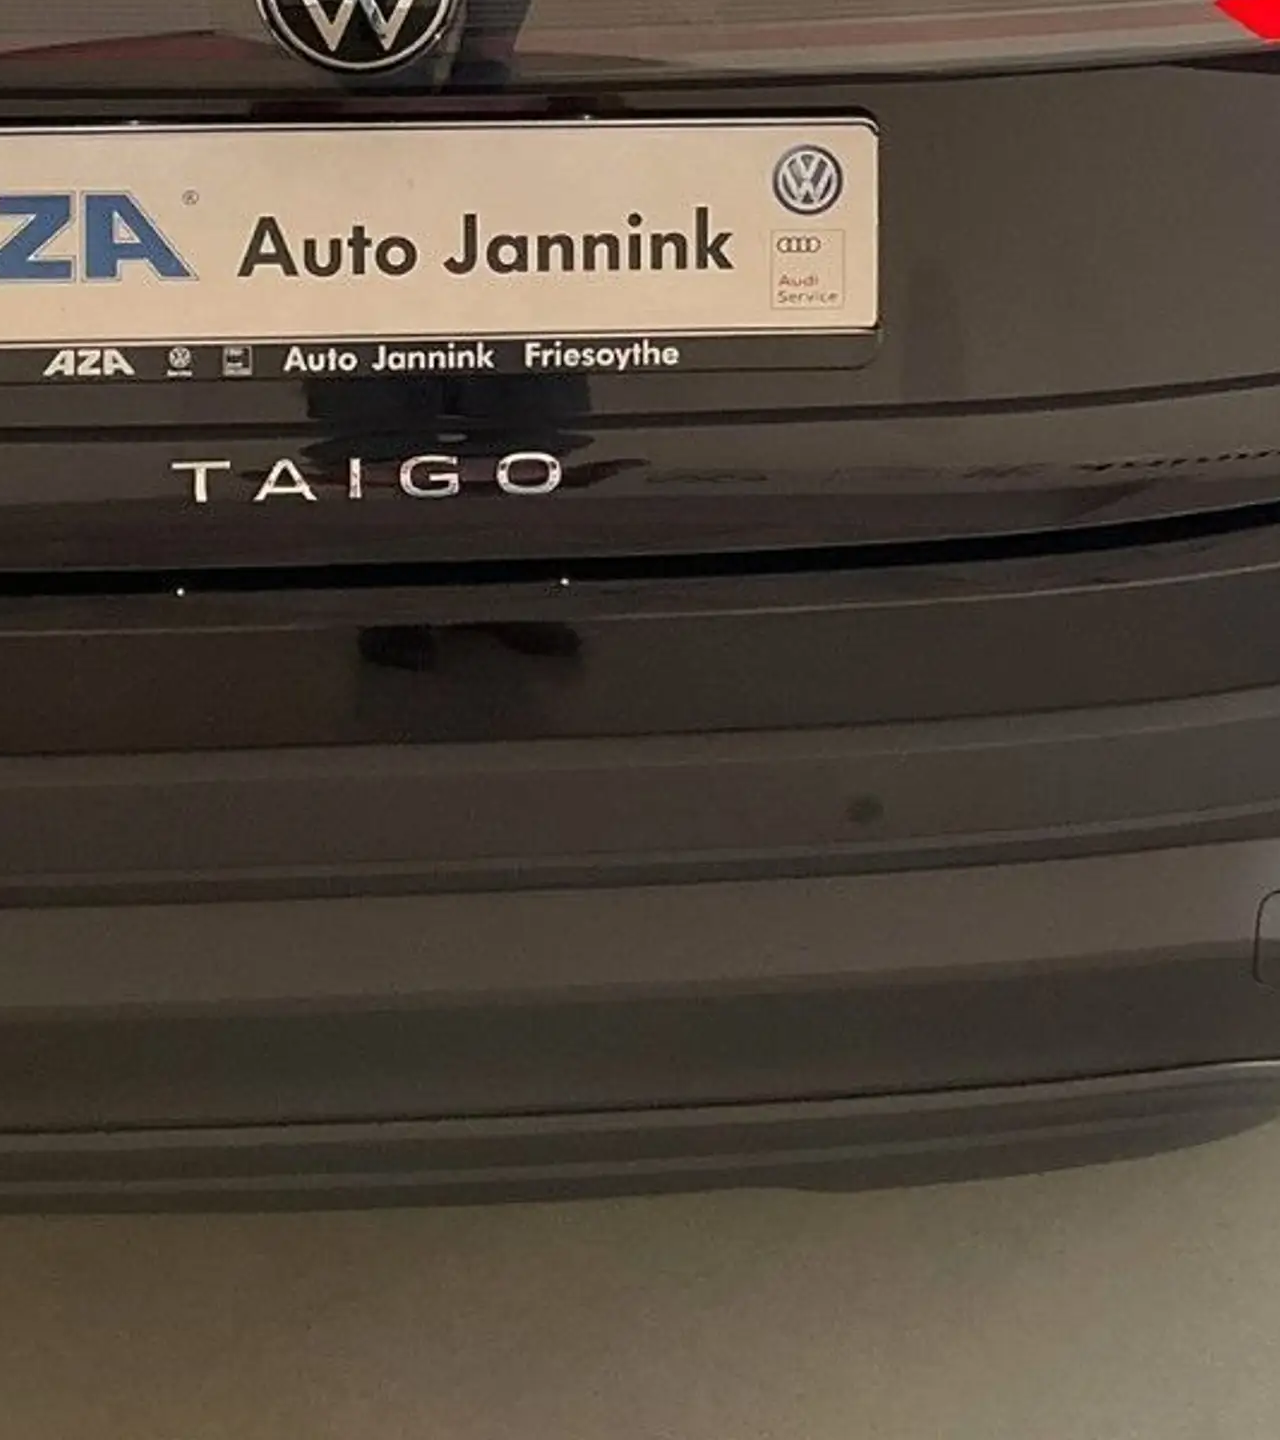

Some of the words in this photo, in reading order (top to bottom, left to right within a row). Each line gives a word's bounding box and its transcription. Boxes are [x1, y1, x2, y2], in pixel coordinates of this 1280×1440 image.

[237, 216, 417, 277] Auto
[443, 206, 735, 275] Jannink
[778, 274, 819, 287] Audi
[777, 291, 839, 304] Service
[42, 348, 135, 376] AZA
[283, 346, 358, 372] Auto
[371, 342, 495, 371] Jannink
[523, 340, 680, 371] Friesoythe
[171, 451, 563, 503] TAIGO
